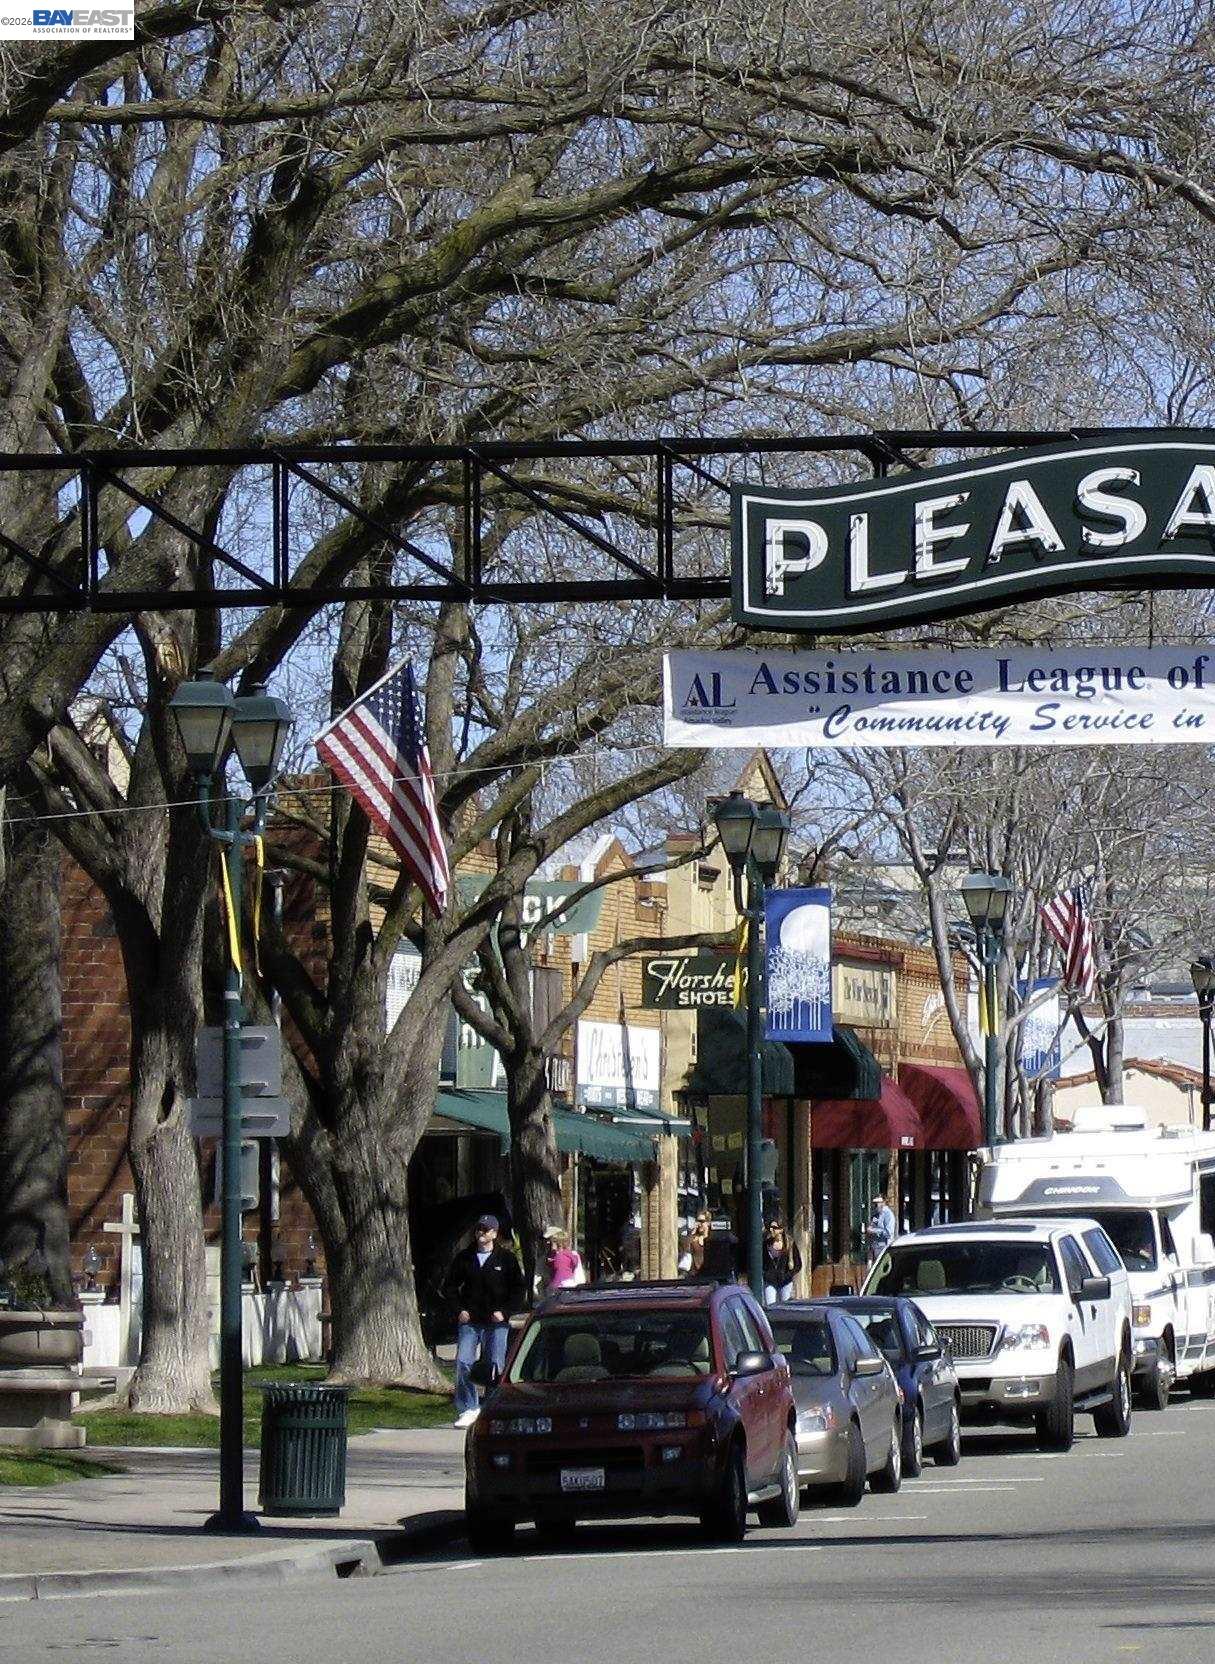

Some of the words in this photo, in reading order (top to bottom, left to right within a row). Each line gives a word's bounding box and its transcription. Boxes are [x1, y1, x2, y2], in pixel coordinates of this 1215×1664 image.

[682, 673, 736, 707] AL
[748, 662, 974, 695] Assistance
[996, 658, 1148, 699] League
[1167, 656, 1209, 689] of
[1030, 702, 1154, 731] Service
[1173, 708, 1205, 728] in
